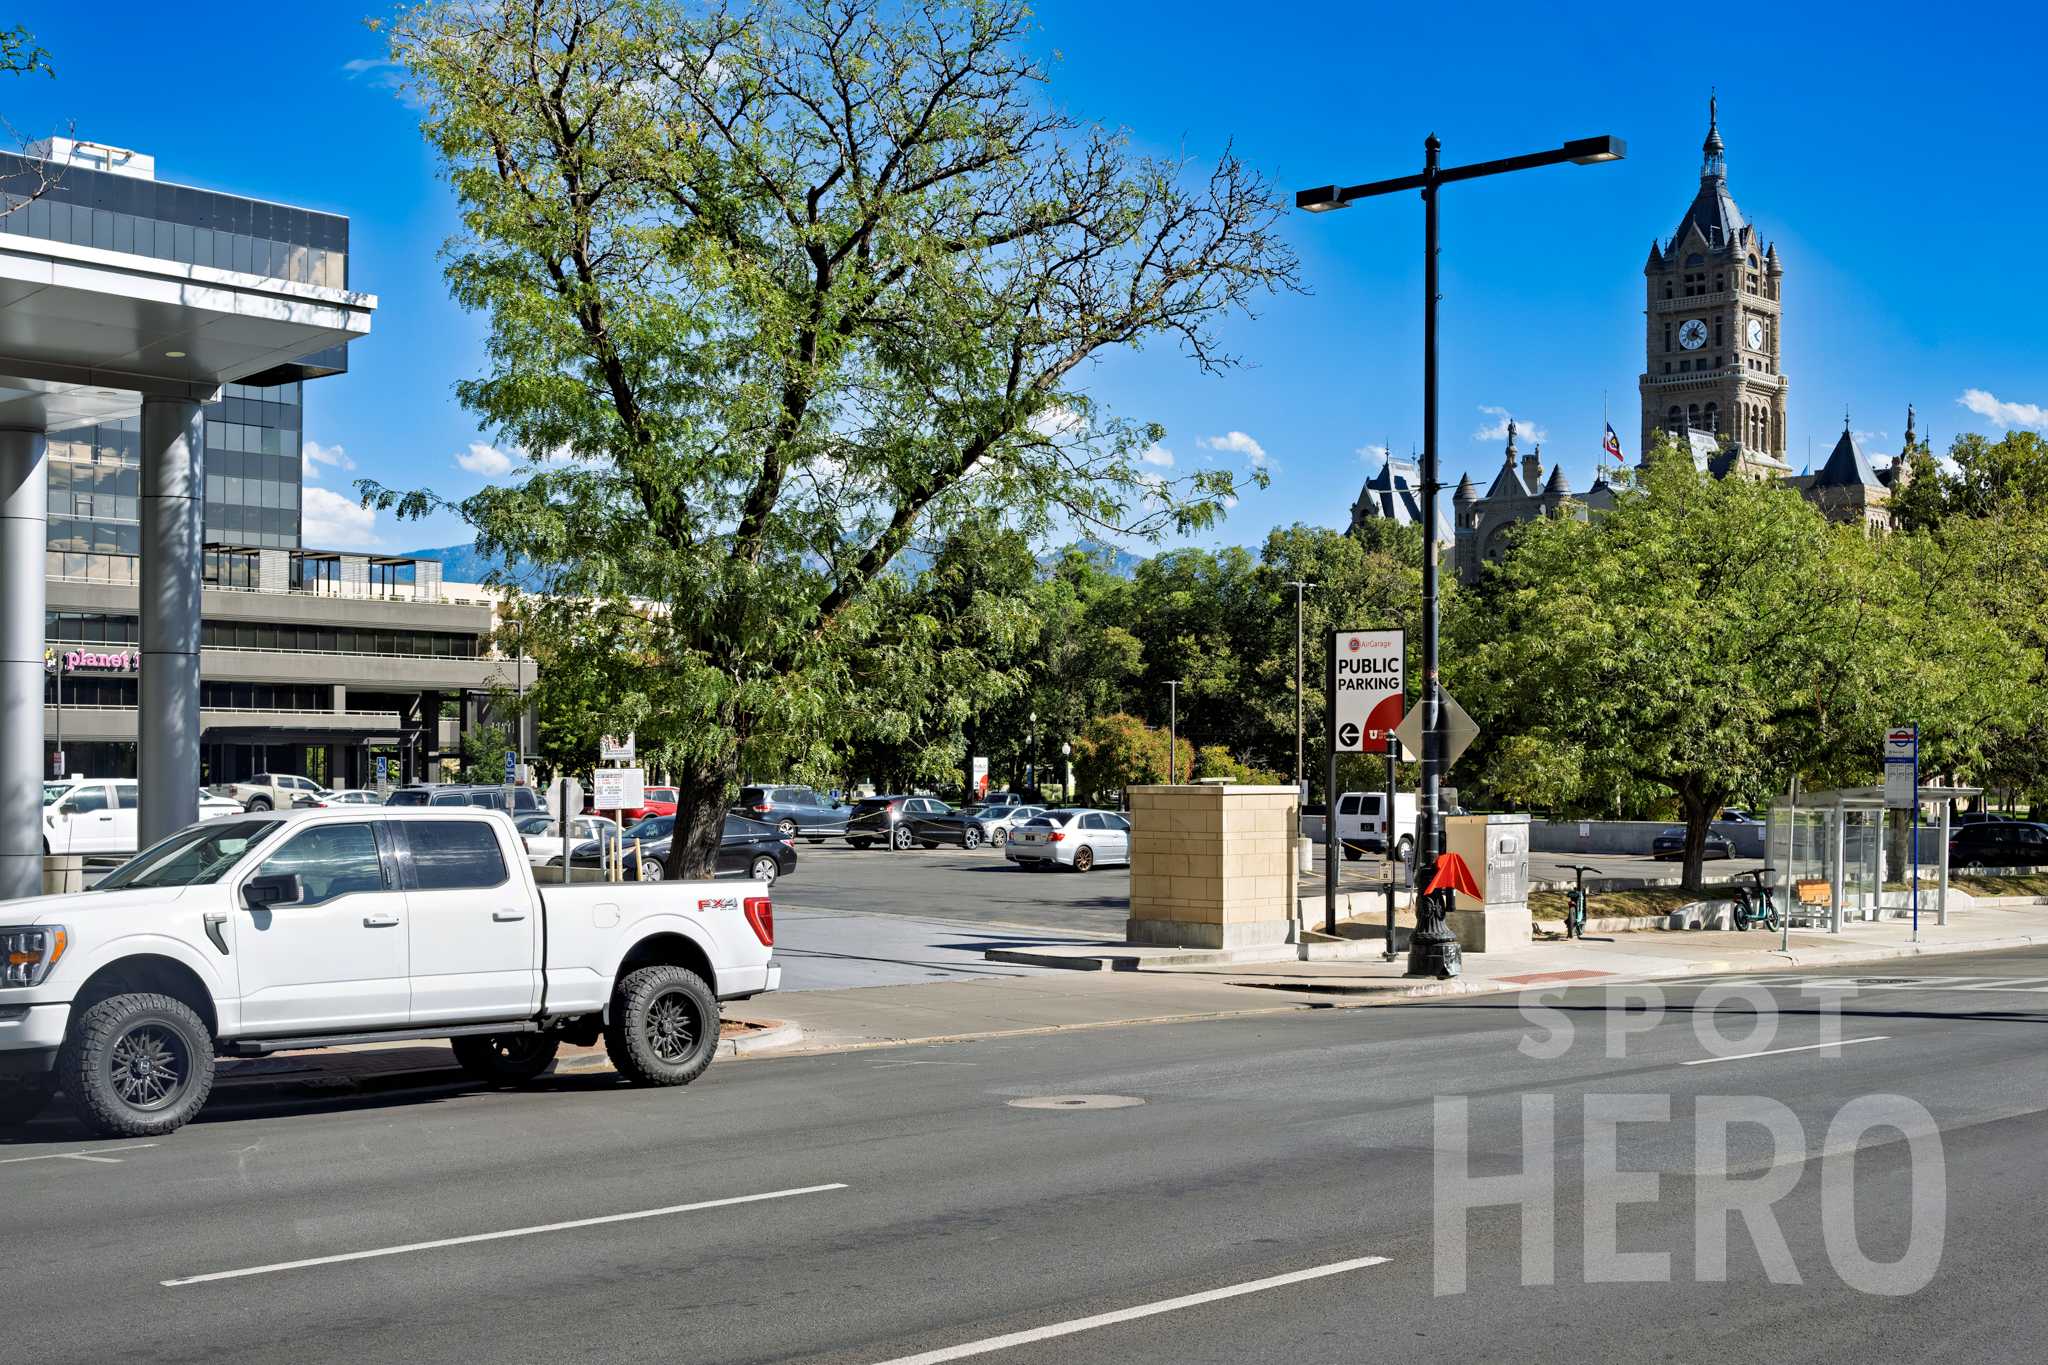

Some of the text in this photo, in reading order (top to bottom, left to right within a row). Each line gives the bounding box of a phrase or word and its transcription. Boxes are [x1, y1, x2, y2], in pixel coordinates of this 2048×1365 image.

[1361, 640, 1391, 648] AirGarage
[64, 648, 129, 670] planet
[1338, 658, 1399, 674] PUBLIC
[1338, 677, 1399, 690] PARKING
[697, 897, 738, 912] FX4
